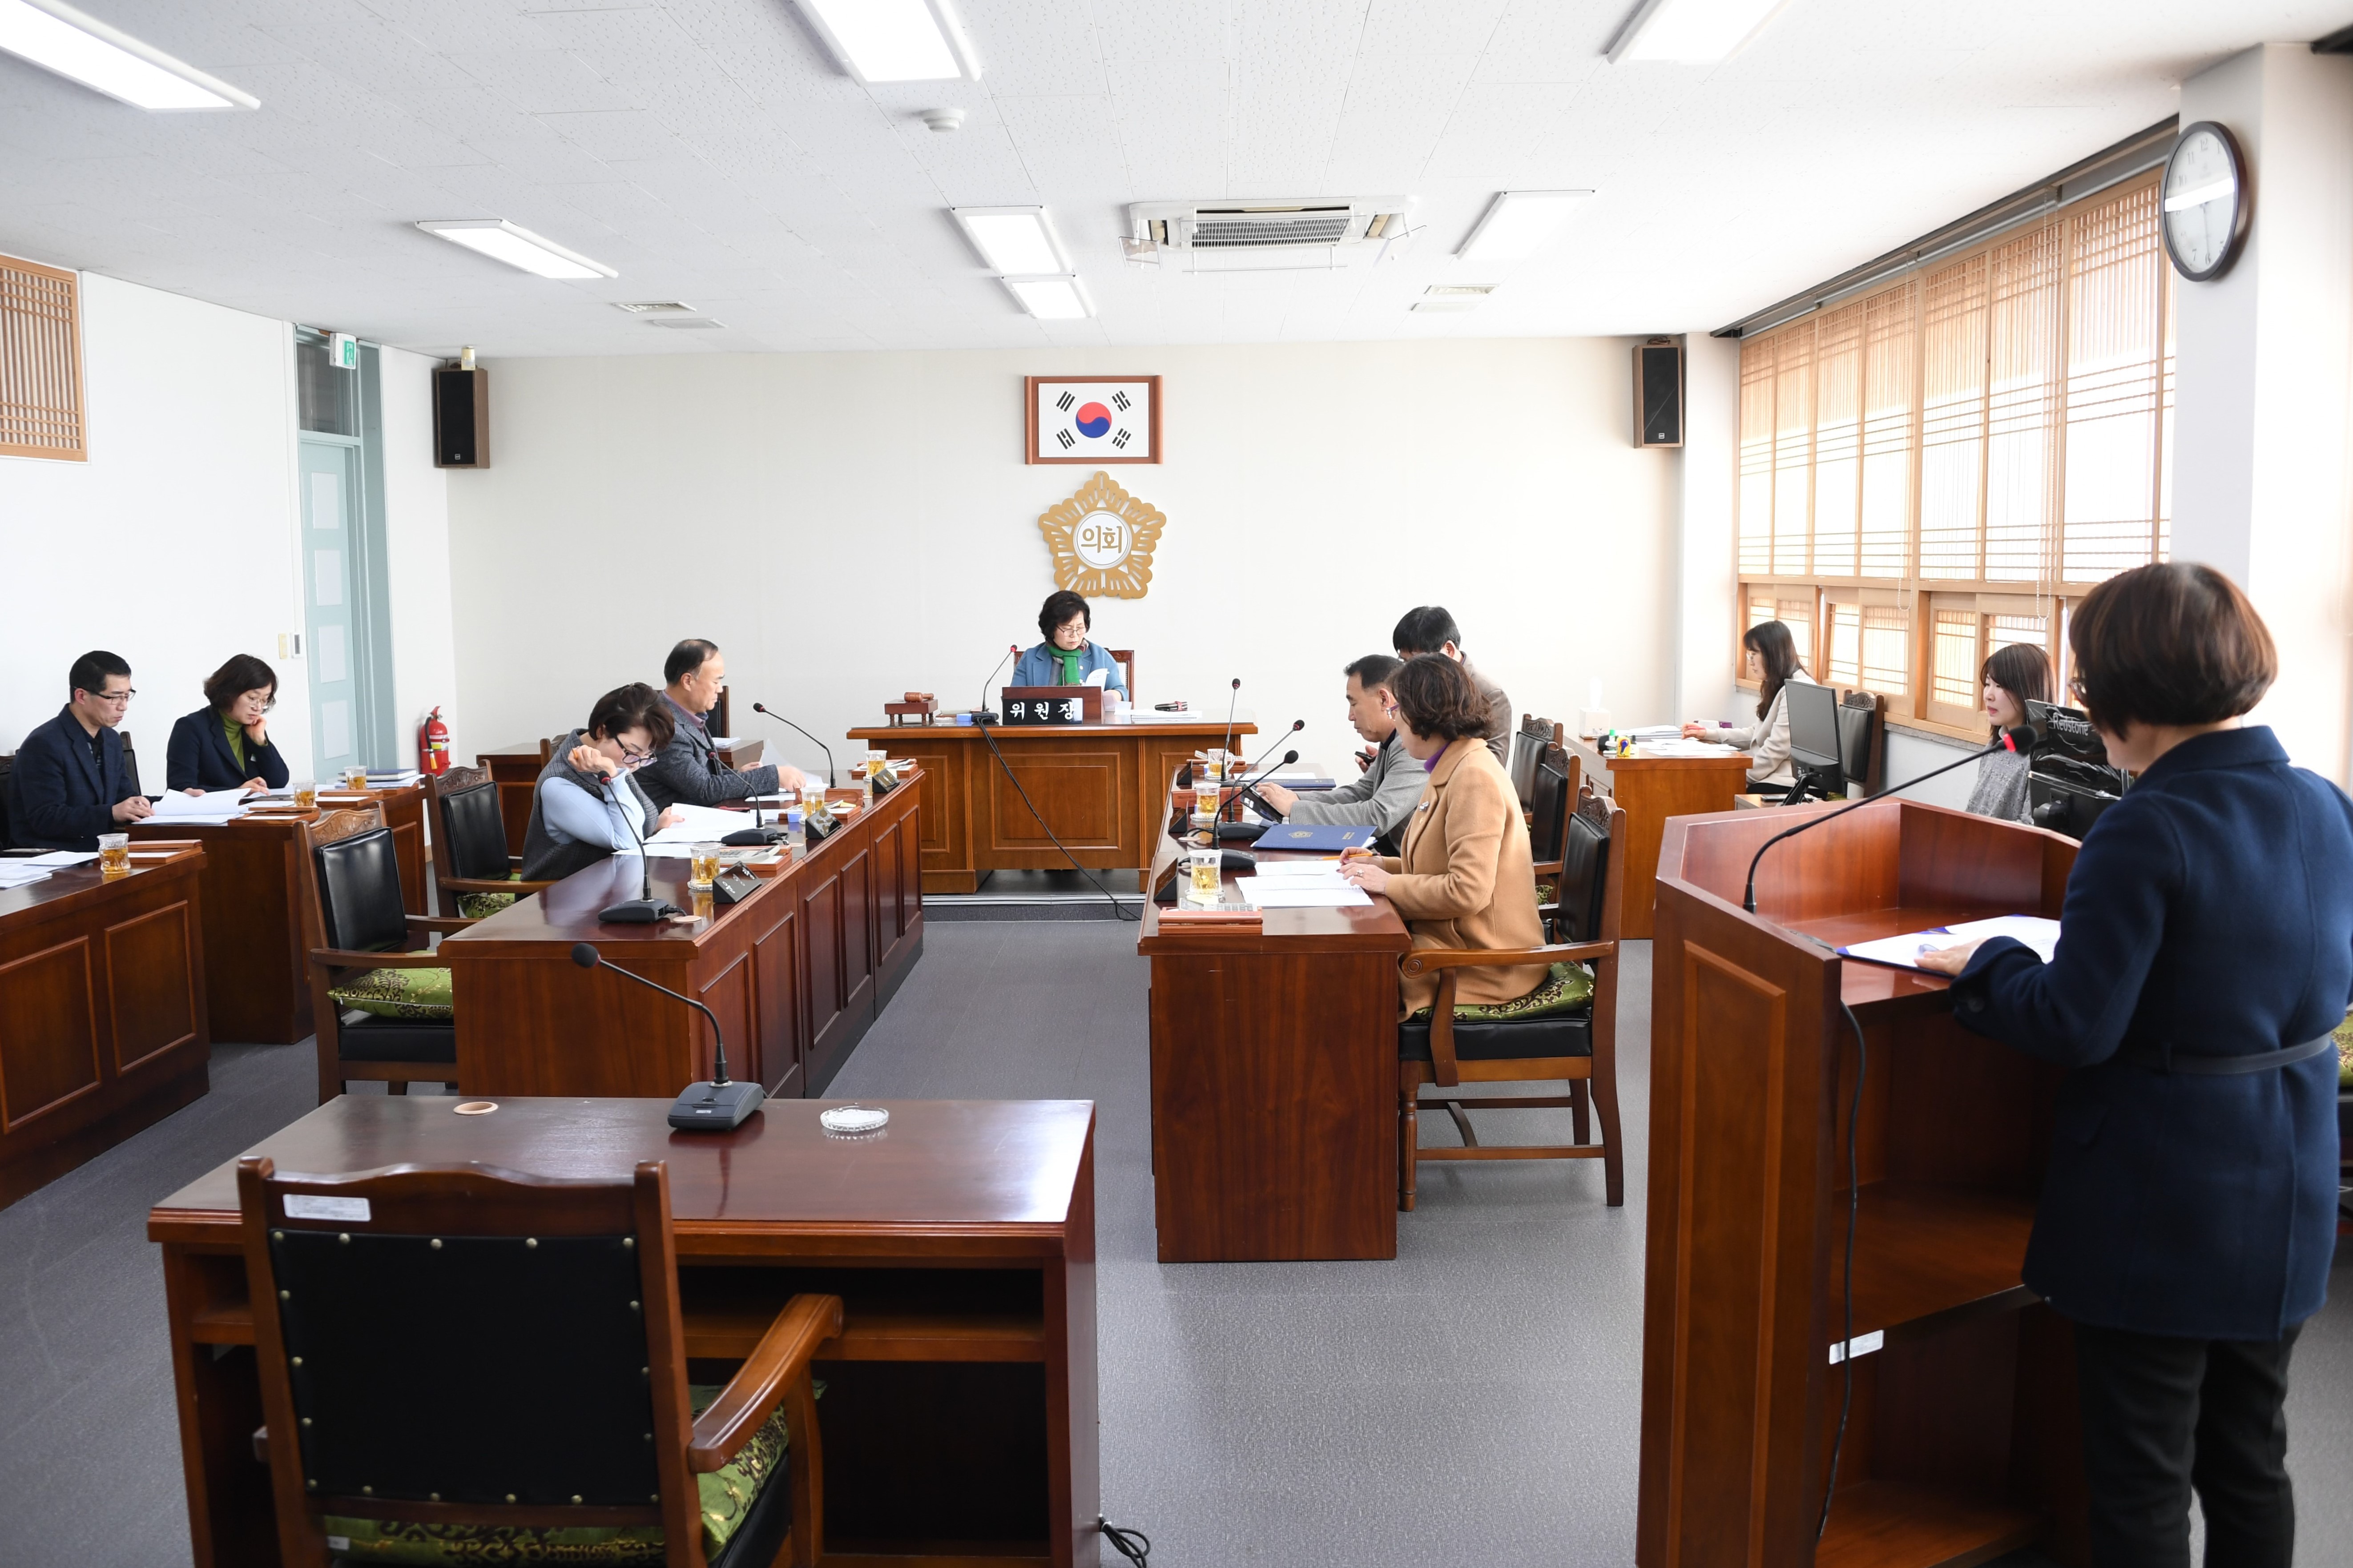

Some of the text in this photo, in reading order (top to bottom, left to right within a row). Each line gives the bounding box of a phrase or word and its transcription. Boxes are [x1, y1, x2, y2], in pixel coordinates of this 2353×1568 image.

[2192, 248, 2197, 261] 7
[1081, 525, 1122, 553] 의회
[1009, 701, 1076, 720] 위원장
[2053, 712, 2089, 736] Redstone
